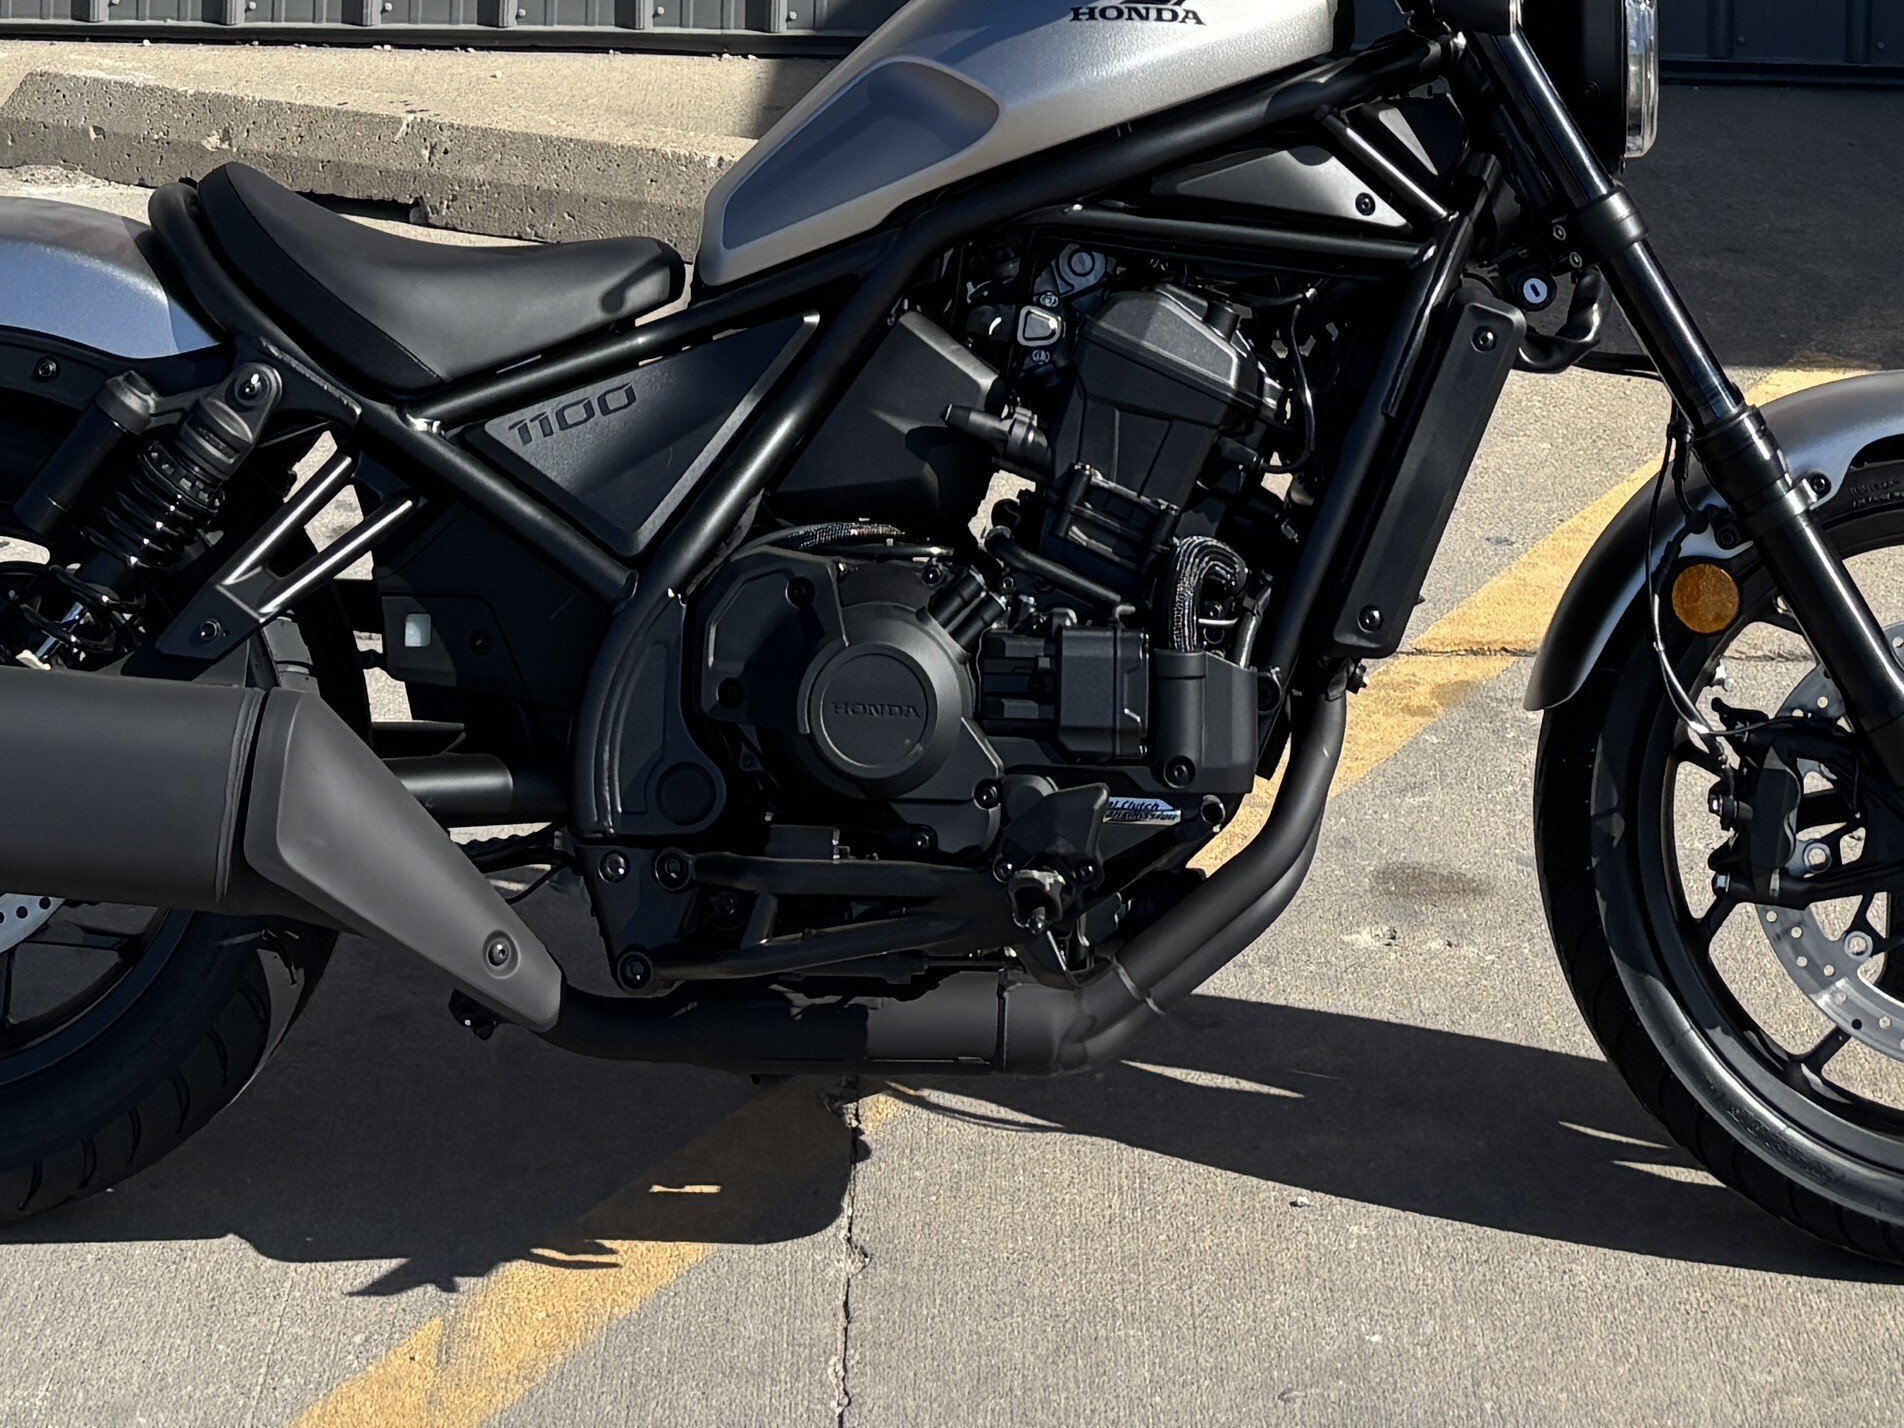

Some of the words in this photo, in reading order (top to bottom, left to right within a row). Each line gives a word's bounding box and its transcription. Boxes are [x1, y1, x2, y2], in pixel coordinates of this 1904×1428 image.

[1069, 5, 1206, 26] HONDA
[508, 382, 637, 448] 1100
[834, 701, 922, 718] HONDA
